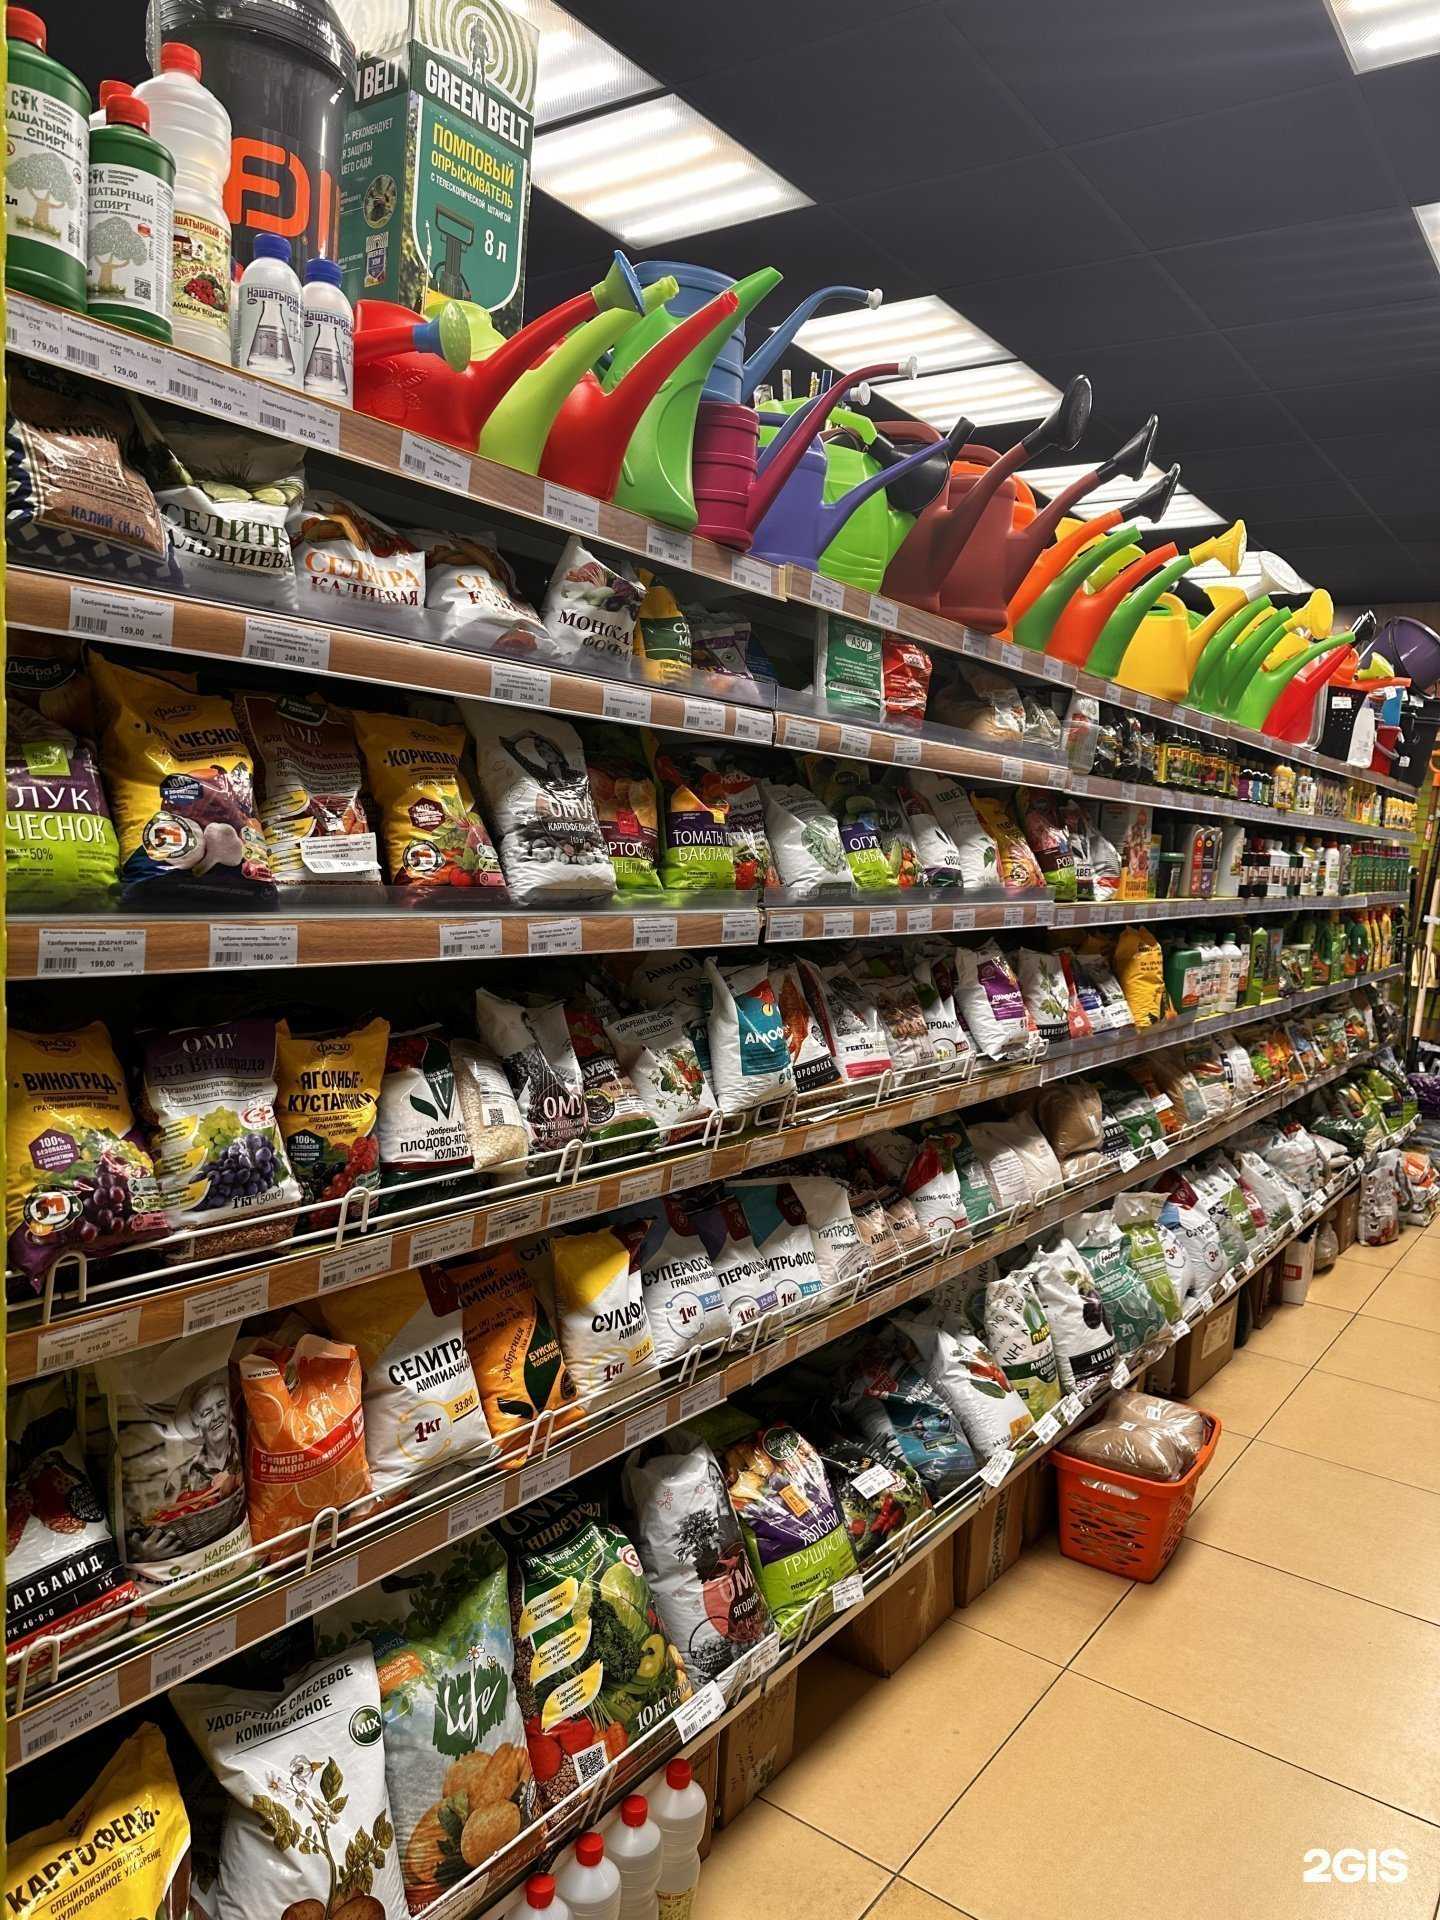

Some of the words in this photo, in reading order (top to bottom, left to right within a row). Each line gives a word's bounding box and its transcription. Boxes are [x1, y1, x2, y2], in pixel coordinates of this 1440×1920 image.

[364, 55, 400, 99] BELT
[425, 59, 485, 126] GREEN
[487, 109, 529, 149] BELT
[27, 128, 66, 150] СПИРТ
[433, 123, 514, 188] ПОМПОВЫЙ
[431, 150, 514, 209] ОПРЫСКИВАТЕЛЬ
[88, 188, 154, 206] ШАТЫРНЫЙ
[436, 175, 486, 210] ТЕЛЕСКОПИЧЕСКОЙ
[94, 200, 131, 211] СПИРТ
[174, 216, 220, 238] ШАТЫРНЫЙ
[484, 229, 495, 254] 8
[497, 242, 508, 263] л
[113, 364, 138, 379] 129,00
[120, 625, 144, 637] 159,00
[15, 786, 92, 811] ЛУК
[6, 814, 106, 845] ЧЕСНОК
[30, 848, 54, 860] 50%
[90, 960, 115, 968] 199,00
[182, 1033, 237, 1054] ОМУ
[300, 1070, 360, 1091] ЯГОДНЫЕ
[796, 1058, 832, 1080] ОРОФОСКА
[23, 1072, 117, 1095] ВИНОГРАД
[288, 1089, 375, 1114] КУСТАРНИКИ
[40, 1136, 65, 1148] 100%
[295, 1135, 316, 1144] 100%
[434, 1146, 469, 1160] КУЛЬТУР
[206, 1709, 287, 1733] УДОБРЕНИЕ
[289, 1663, 354, 1713] СМЕСЕВОЕ
[443, 1674, 503, 1743] Life
[235, 1694, 333, 1745] КОМПЛЕКСНОЕ
[355, 1714, 382, 1738] MIX
[635, 1708, 654, 1731] 10
[5, 1806, 157, 1913] КАРТОФЕЛЬ
[55, 1873, 130, 1920] НУЛИРОВАННОЕ
